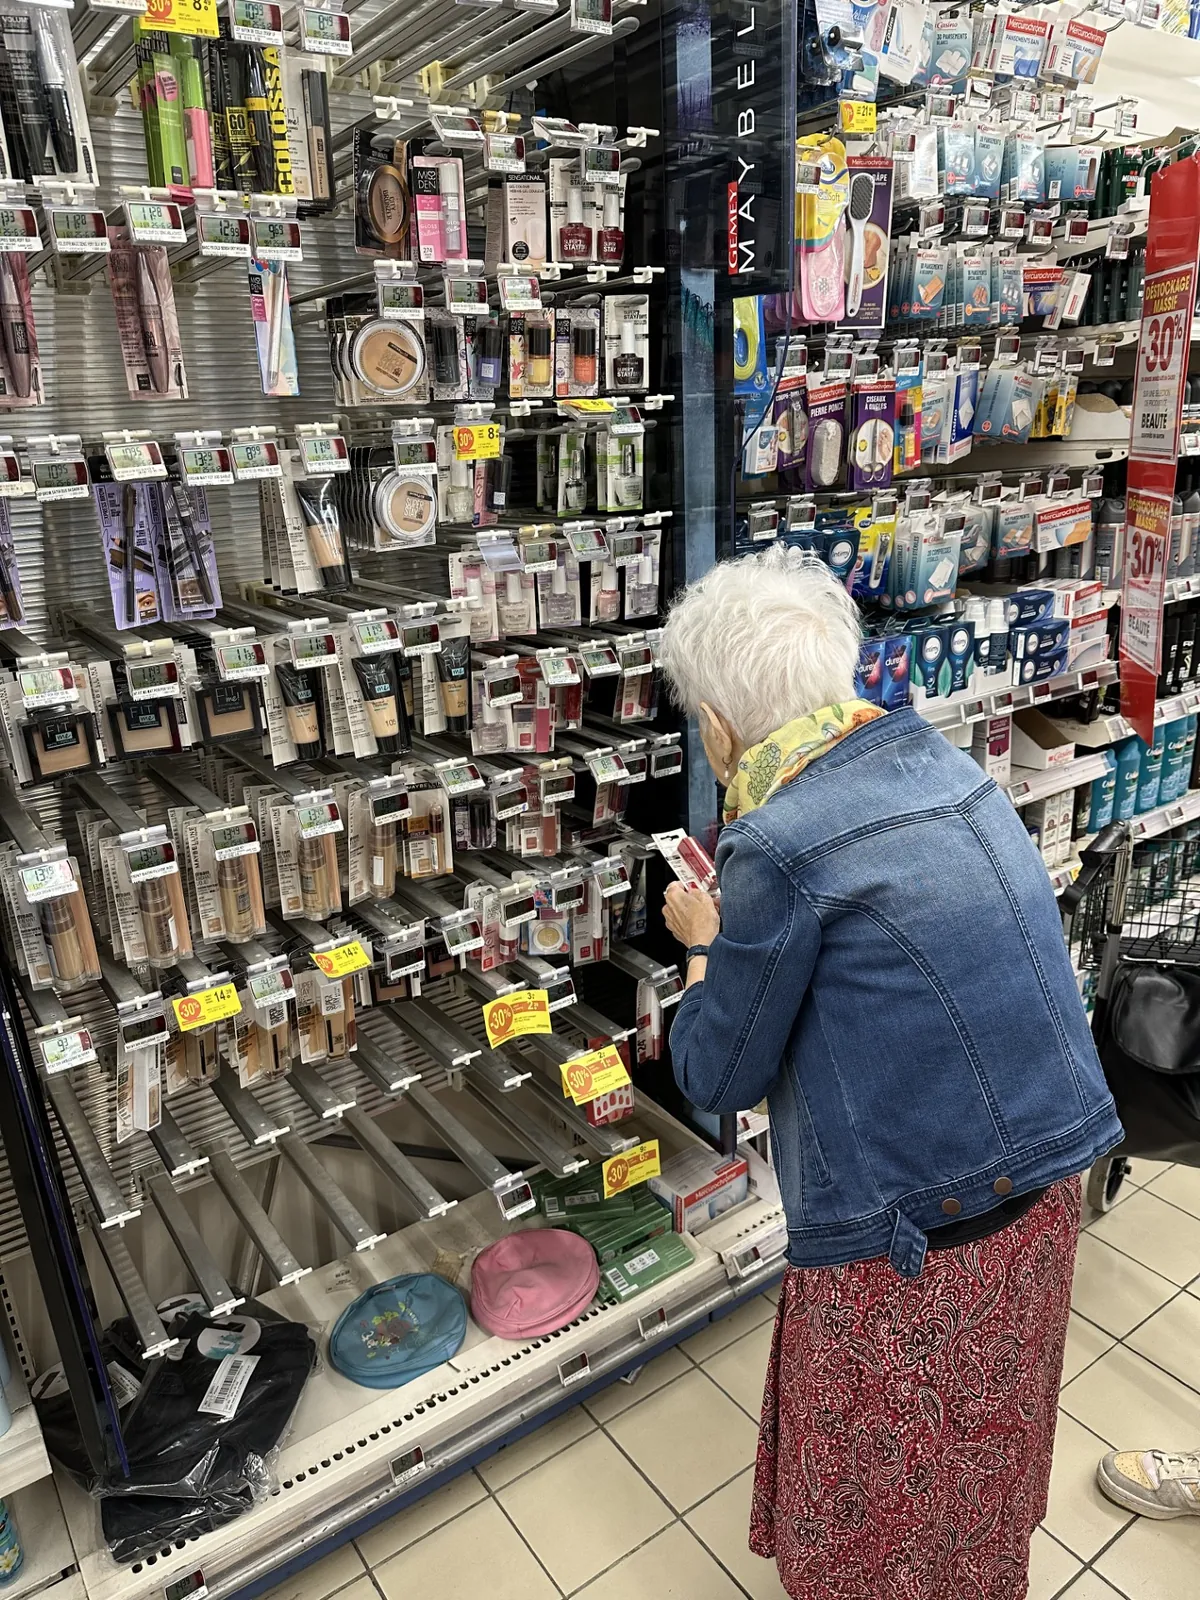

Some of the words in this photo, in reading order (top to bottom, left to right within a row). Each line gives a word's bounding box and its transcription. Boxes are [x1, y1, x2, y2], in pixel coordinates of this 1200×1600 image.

[264, 47, 294, 194] COLOSSA
[737, 7, 755, 274] MAYBEL
[418, 180, 437, 189] DEN
[729, 189, 738, 269] GEMEY
[1145, 274, 1190, 301] DÉSTOCKAGE
[1153, 294, 1178, 314] MASSIF
[808, 387, 845, 400] Mercurochrome
[866, 395, 887, 403] CISEAUX
[811, 407, 828, 418] PIERRE
[828, 402, 844, 414] PONCE
[1141, 408, 1168, 429] BEAUTÉ
[1040, 504, 1090, 522] Mercurochrome
[1135, 512, 1158, 532] MASSIF
[215, 686, 236, 702] FIT
[130, 705, 152, 719] FIT
[46, 721, 70, 739] FIT
[490, 1007, 512, 1030] -30%
[569, 1068, 590, 1089] -30%
[608, 1162, 628, 1183] -30%
